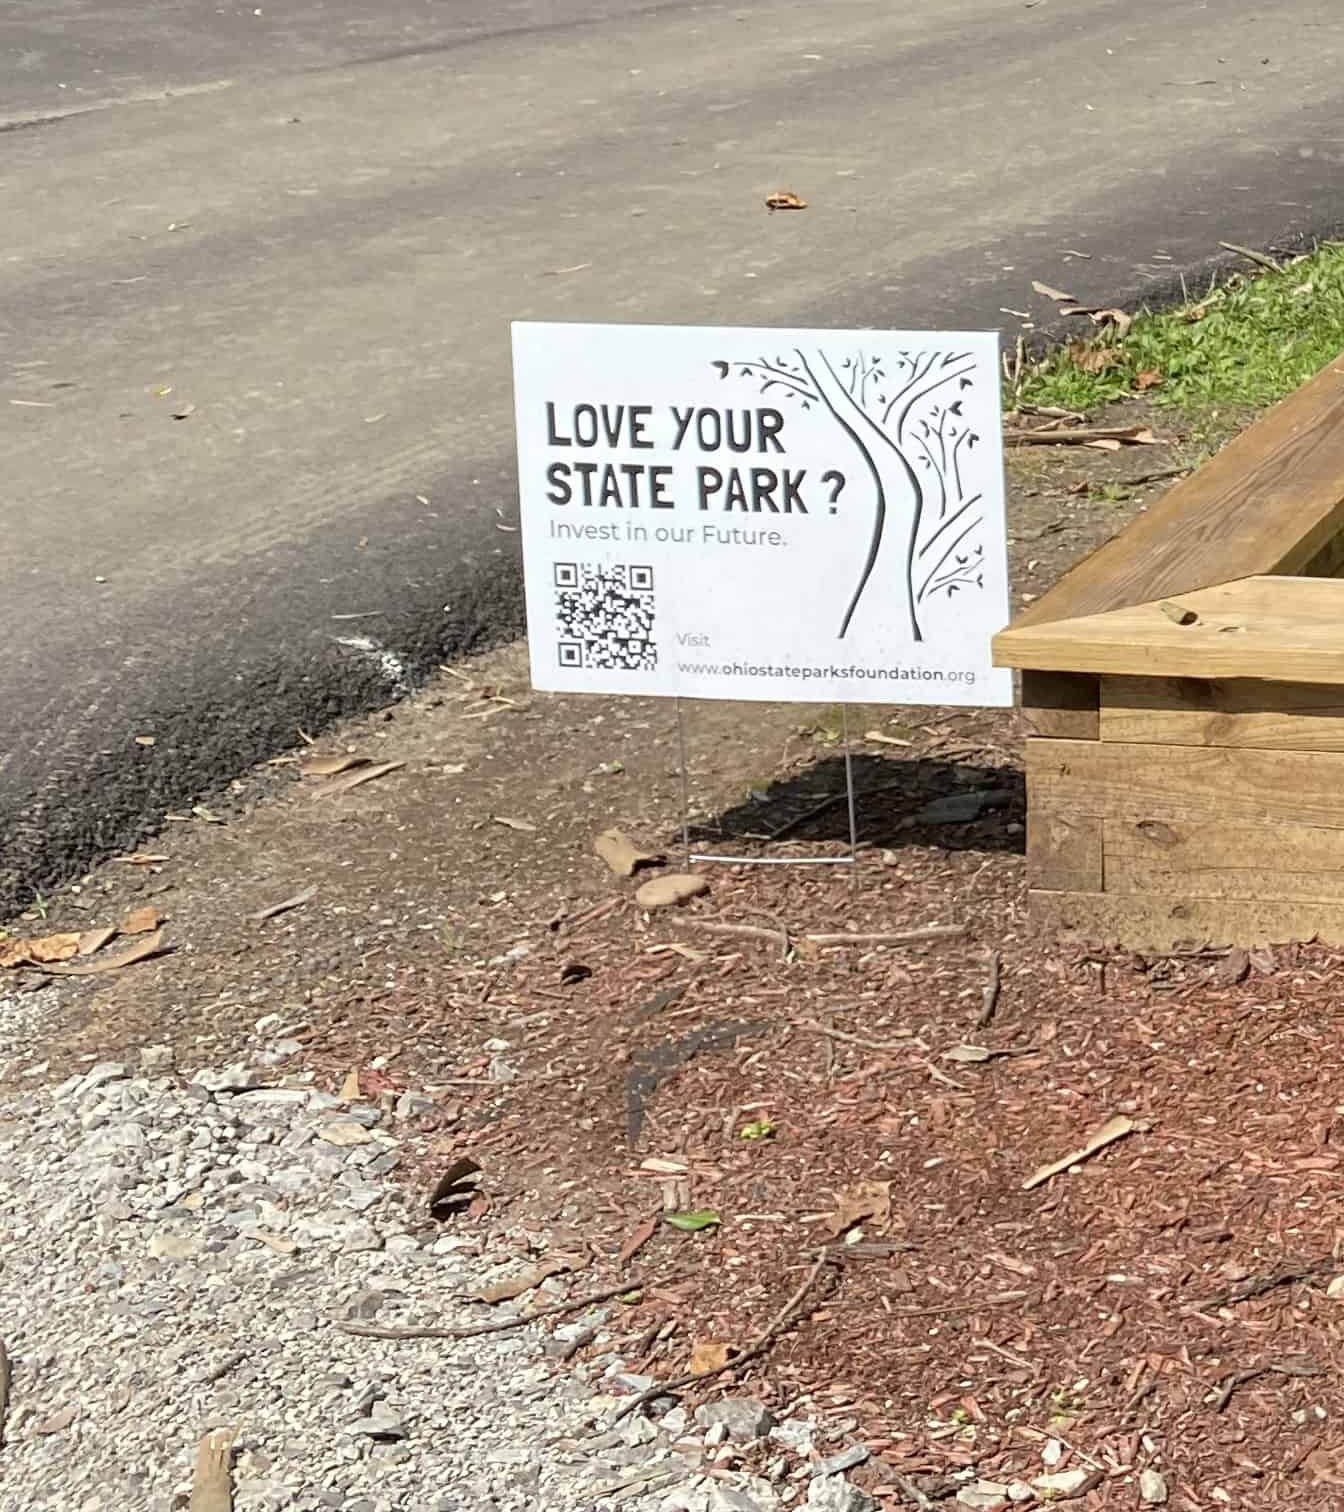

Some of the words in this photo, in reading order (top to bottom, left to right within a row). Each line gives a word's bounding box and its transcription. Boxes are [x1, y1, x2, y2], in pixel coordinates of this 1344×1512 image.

[547, 402, 654, 448] LOVE
[671, 407, 785, 453] YOUR
[547, 462, 674, 509] STATE
[550, 520, 619, 541] Invest
[626, 521, 647, 542] in
[656, 524, 693, 543] our
[702, 526, 787, 547] Future.
[676, 633, 710, 647] Visit
[678, 662, 975, 684] www.ohiostateparksfoundation.org
